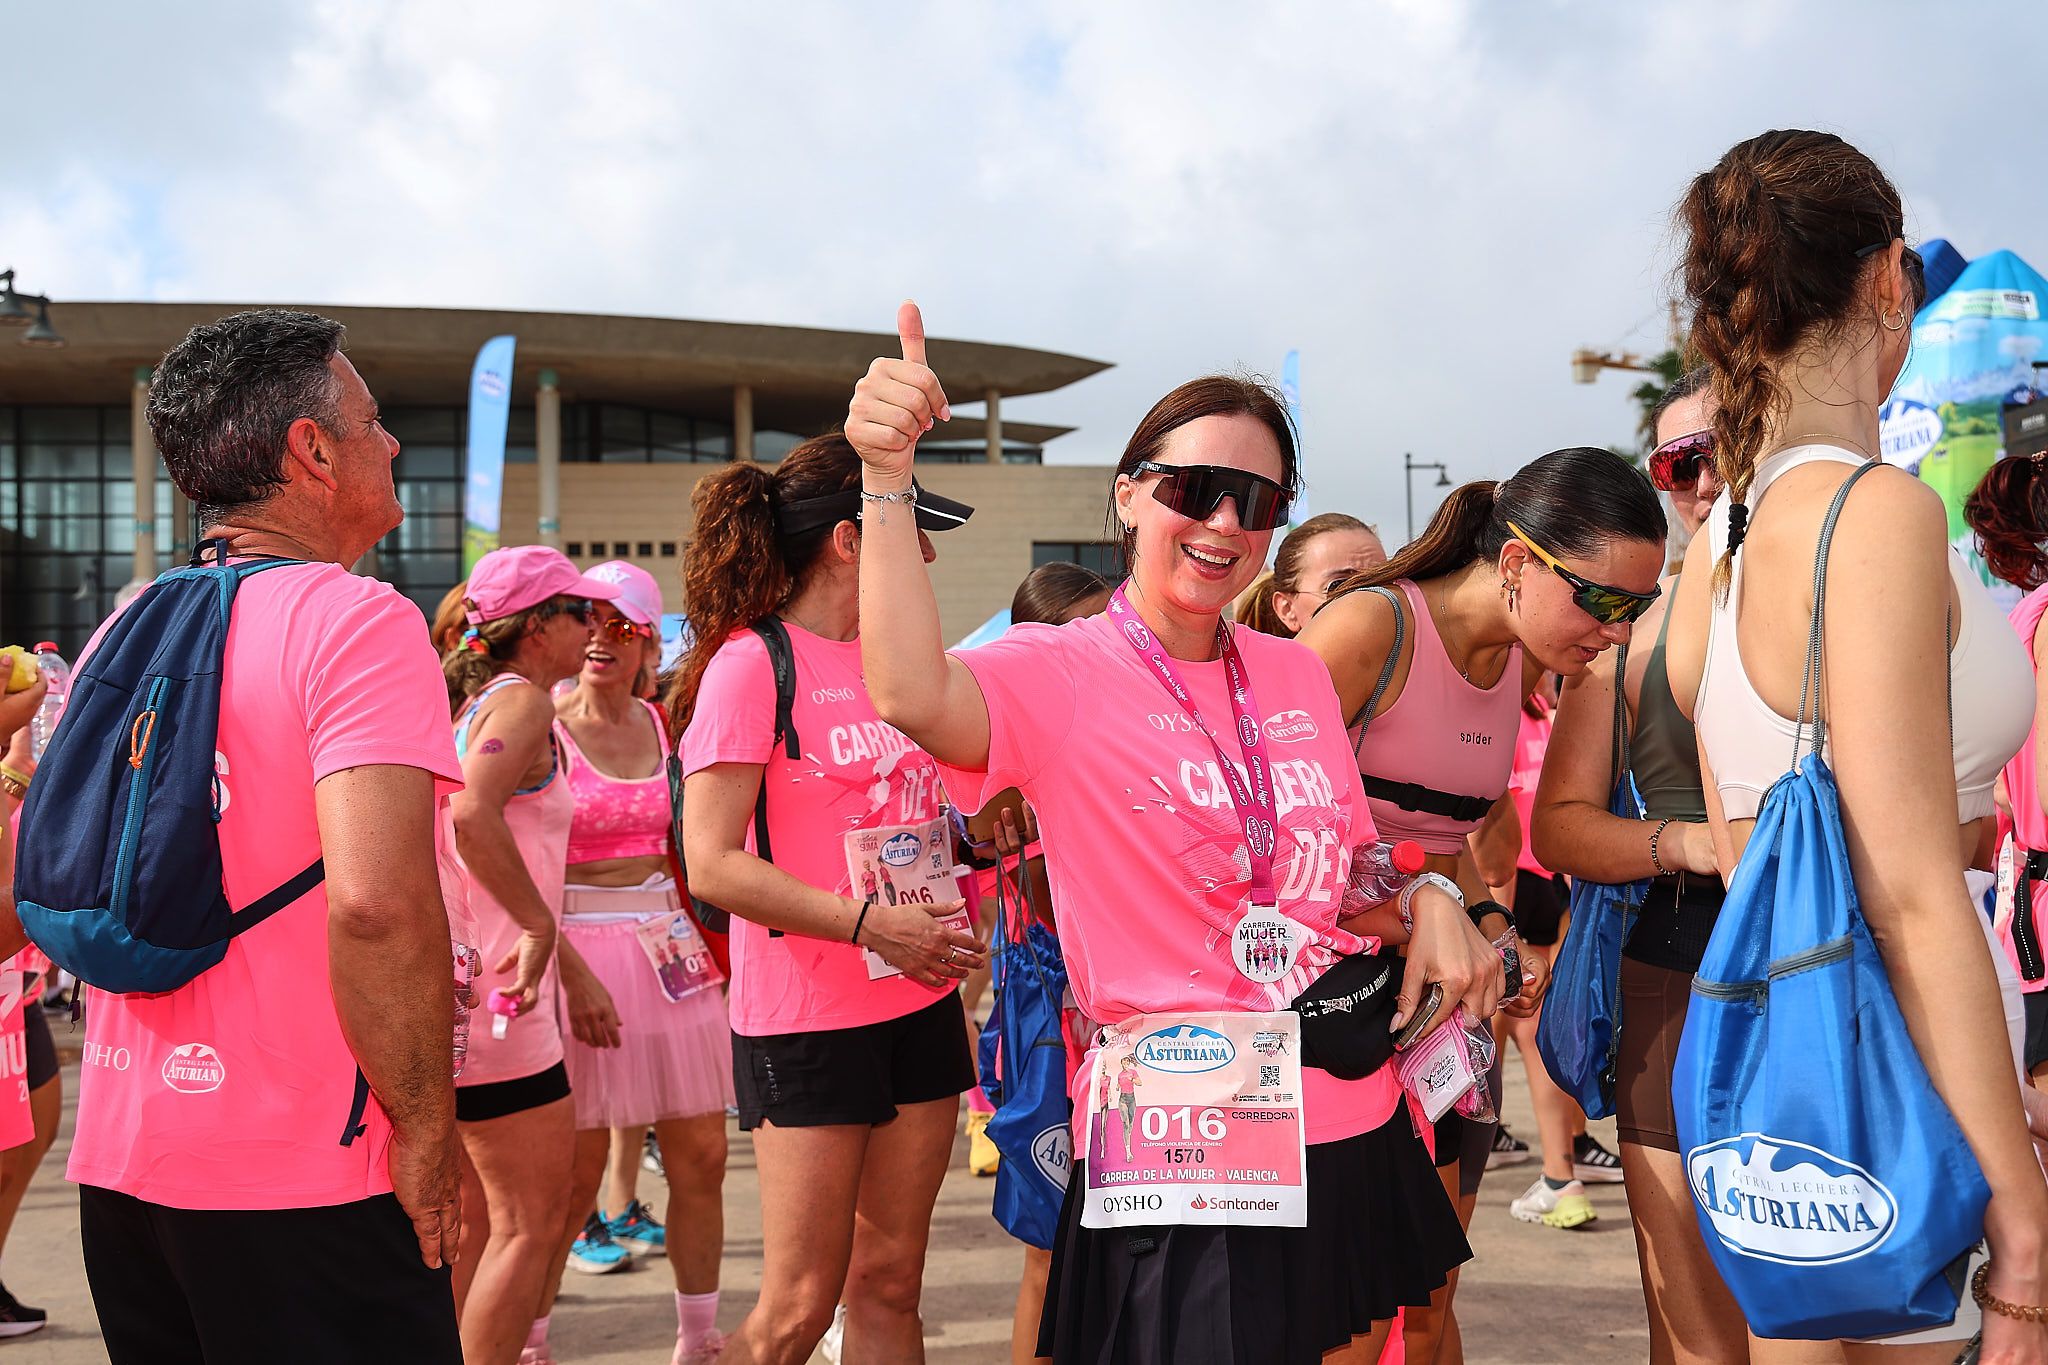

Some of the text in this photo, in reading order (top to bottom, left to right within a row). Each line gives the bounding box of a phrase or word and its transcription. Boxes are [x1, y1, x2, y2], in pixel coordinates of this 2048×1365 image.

[1147, 713, 1217, 737] OYS
[1460, 732, 1492, 745] spider
[1178, 758, 1338, 810] CAERA
[1242, 921, 1276, 929] CARRERA
[1239, 927, 1287, 941] MUJER
[1358, 983, 1375, 1001] LOLA
[83, 1041, 131, 1071] OHO
[1142, 1042, 1229, 1061] ASTURIANA
[1141, 1106, 1227, 1141] 016
[1231, 1111, 1295, 1120] CORREDORA
[1164, 1148, 1205, 1164] 1570
[1100, 1168, 1279, 1184] CARRERA DE LA MUJER VALENCIA
[1781, 1182, 1861, 1195] LECHERA
[1103, 1194, 1163, 1213] OYSHO
[1210, 1197, 1279, 1211] Santander
[1701, 1165, 1879, 1232] ASTURIANA
